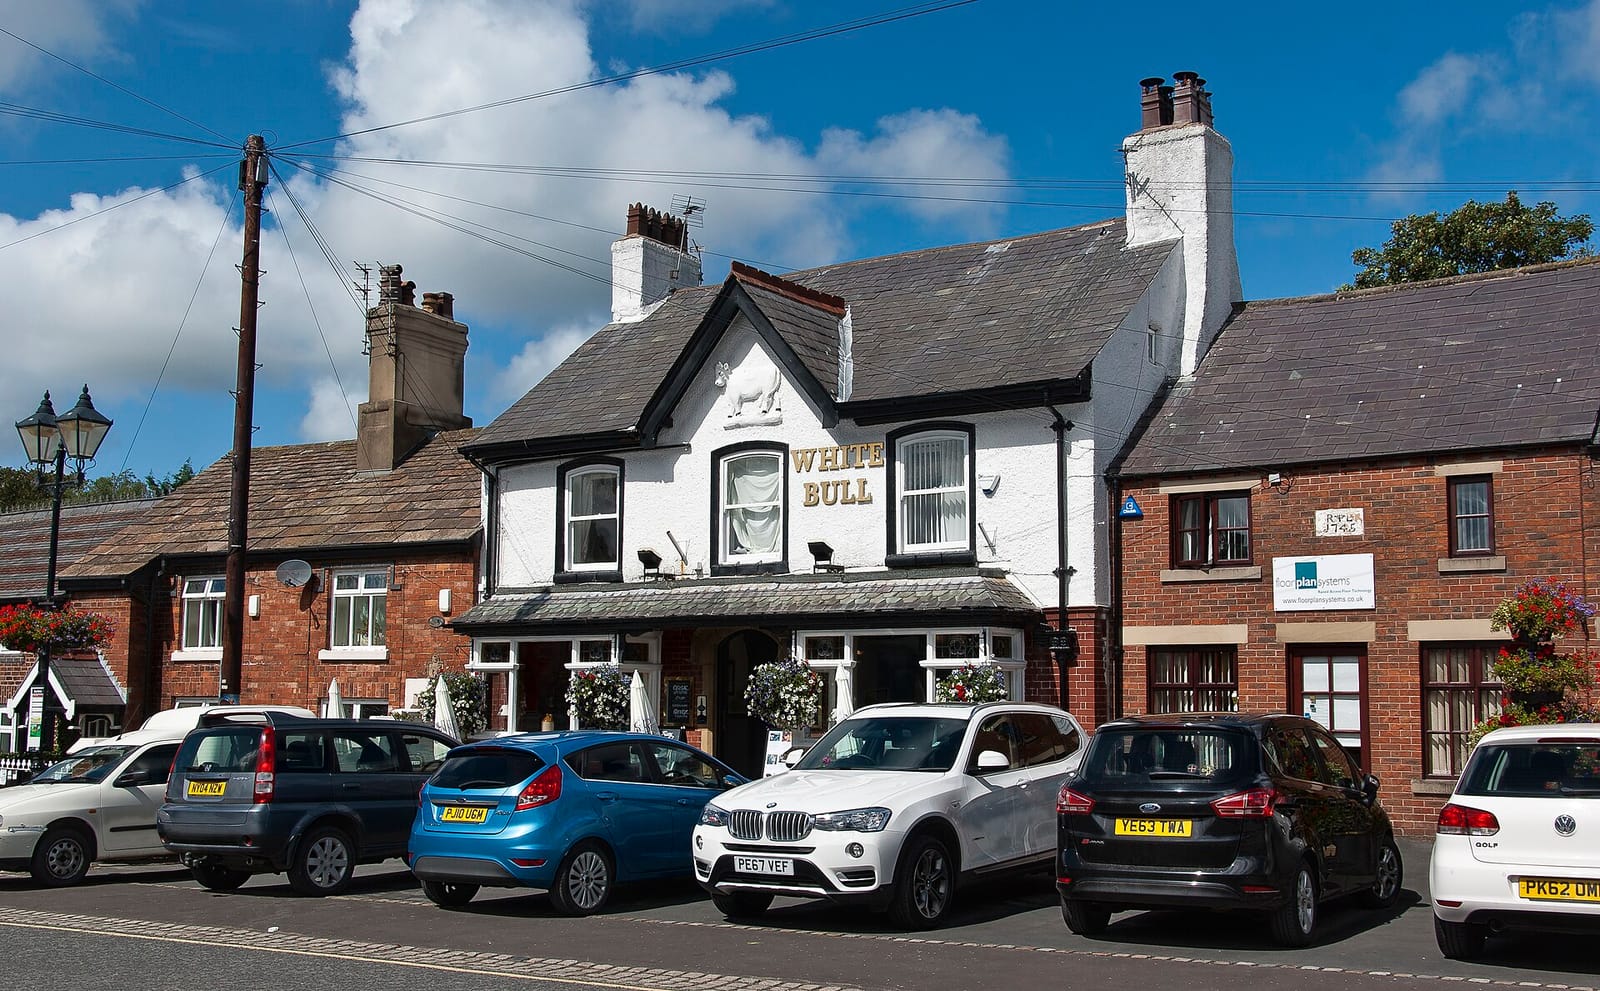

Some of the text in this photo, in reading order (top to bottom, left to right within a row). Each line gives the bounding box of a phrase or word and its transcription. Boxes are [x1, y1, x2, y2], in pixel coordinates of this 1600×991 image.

[791, 442, 884, 473] WHITE
[803, 478, 873, 507] BULL
[1282, 595, 1364, 604] www.floorplansystems.co.uk
[191, 783, 208, 794] NY04
[446, 808, 465, 819] PJ10
[1122, 820, 1184, 833] YE63 TWA
[738, 858, 789, 872] PE67 VEF
[1526, 880, 1570, 896] PK62
